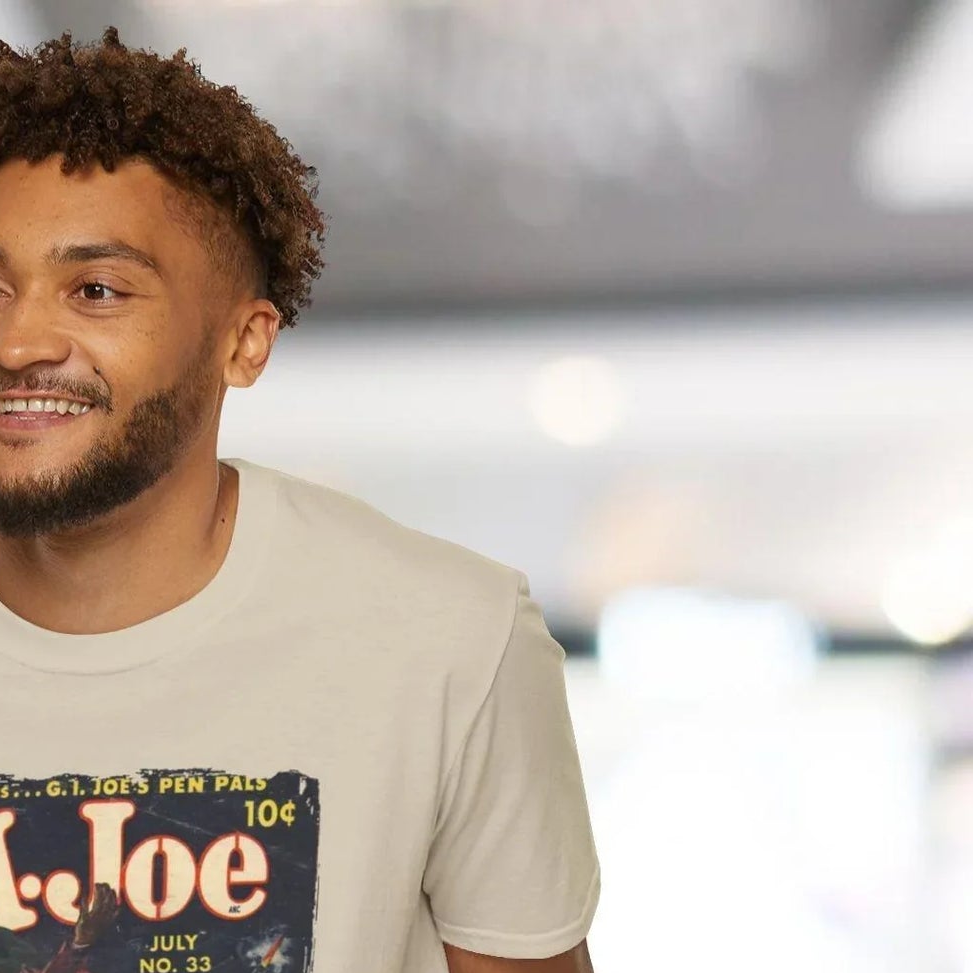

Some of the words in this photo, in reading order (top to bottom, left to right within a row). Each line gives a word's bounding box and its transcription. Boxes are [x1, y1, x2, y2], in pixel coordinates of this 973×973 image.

[93, 778, 149, 796] JOES
[159, 776, 204, 794] PEN
[214, 774, 268, 793] PALS
[244, 798, 297, 828] 10¢
[149, 933, 198, 953] JULY
[185, 955, 213, 973] 33
